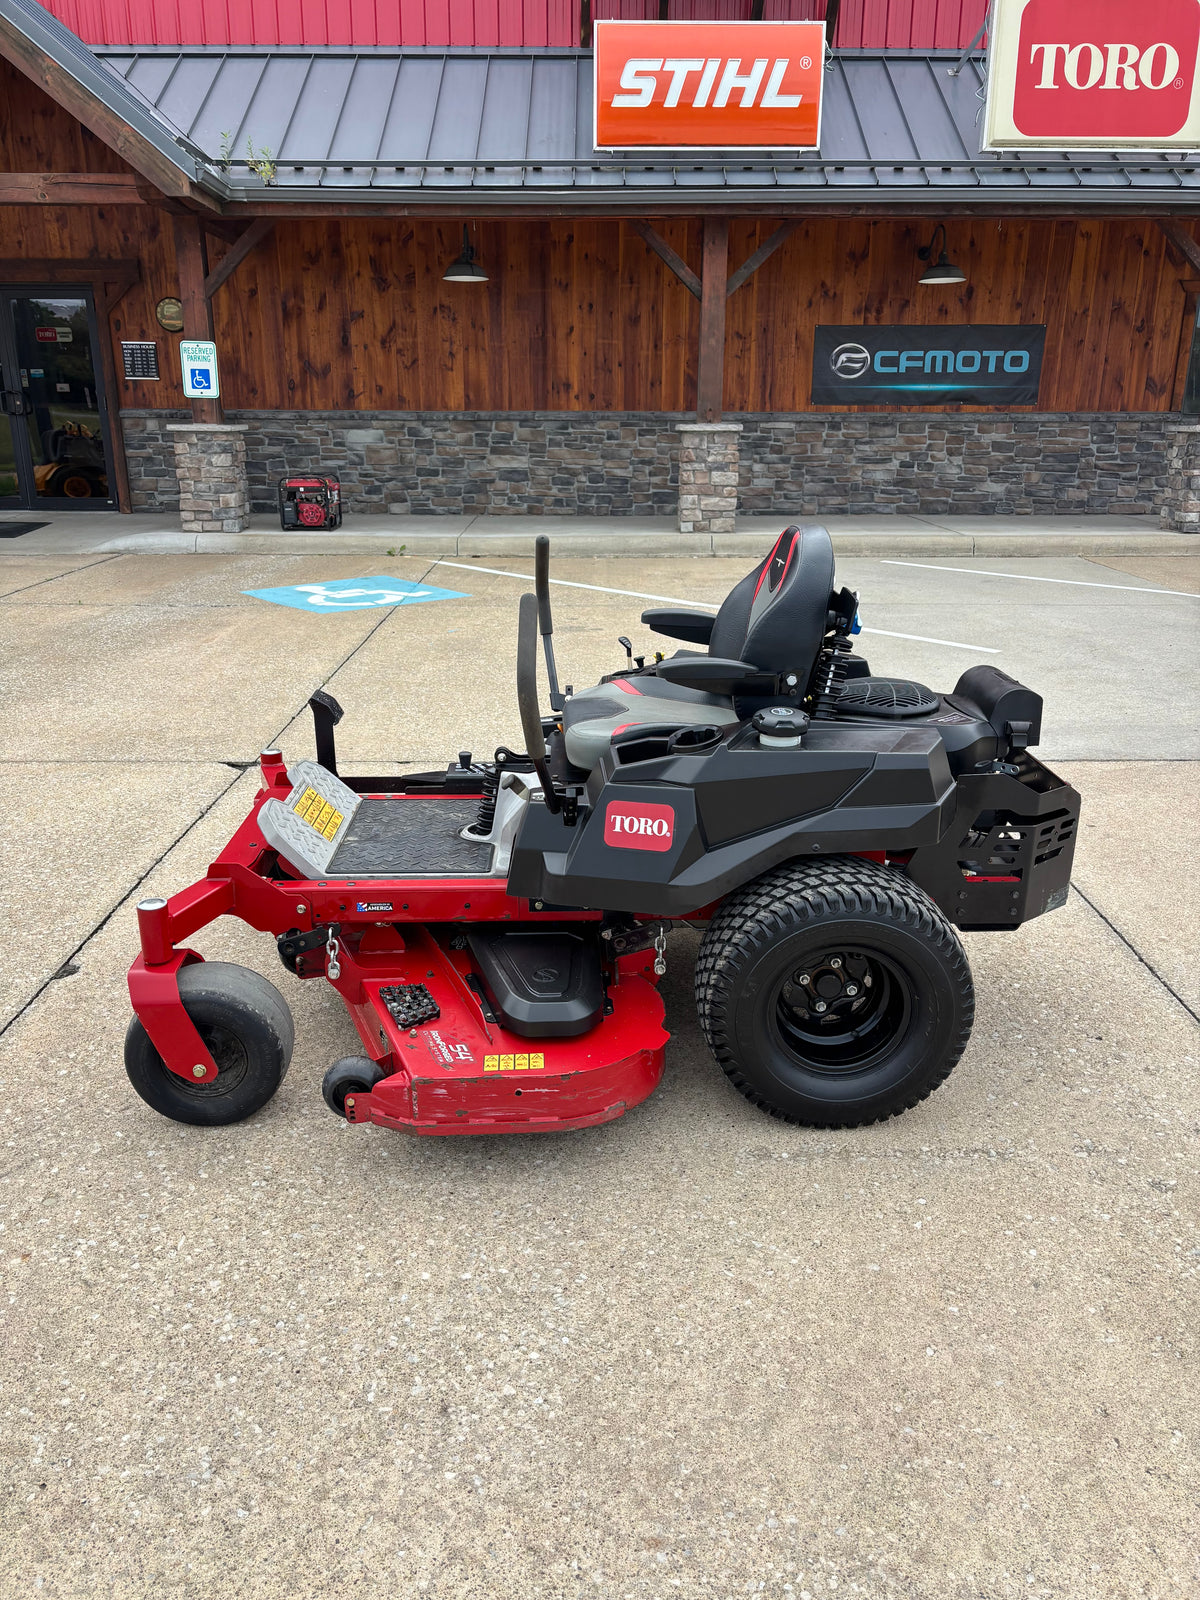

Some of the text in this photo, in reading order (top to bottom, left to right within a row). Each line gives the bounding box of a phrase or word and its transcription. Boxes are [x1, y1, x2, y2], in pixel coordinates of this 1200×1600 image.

[1030, 42, 1180, 91] TORO
[611, 58, 803, 108] STIHL
[183, 346, 213, 355] RESERVED
[186, 354, 212, 363] PARKING
[873, 350, 1030, 373] CFMOTO
[610, 814, 669, 837] TORO
